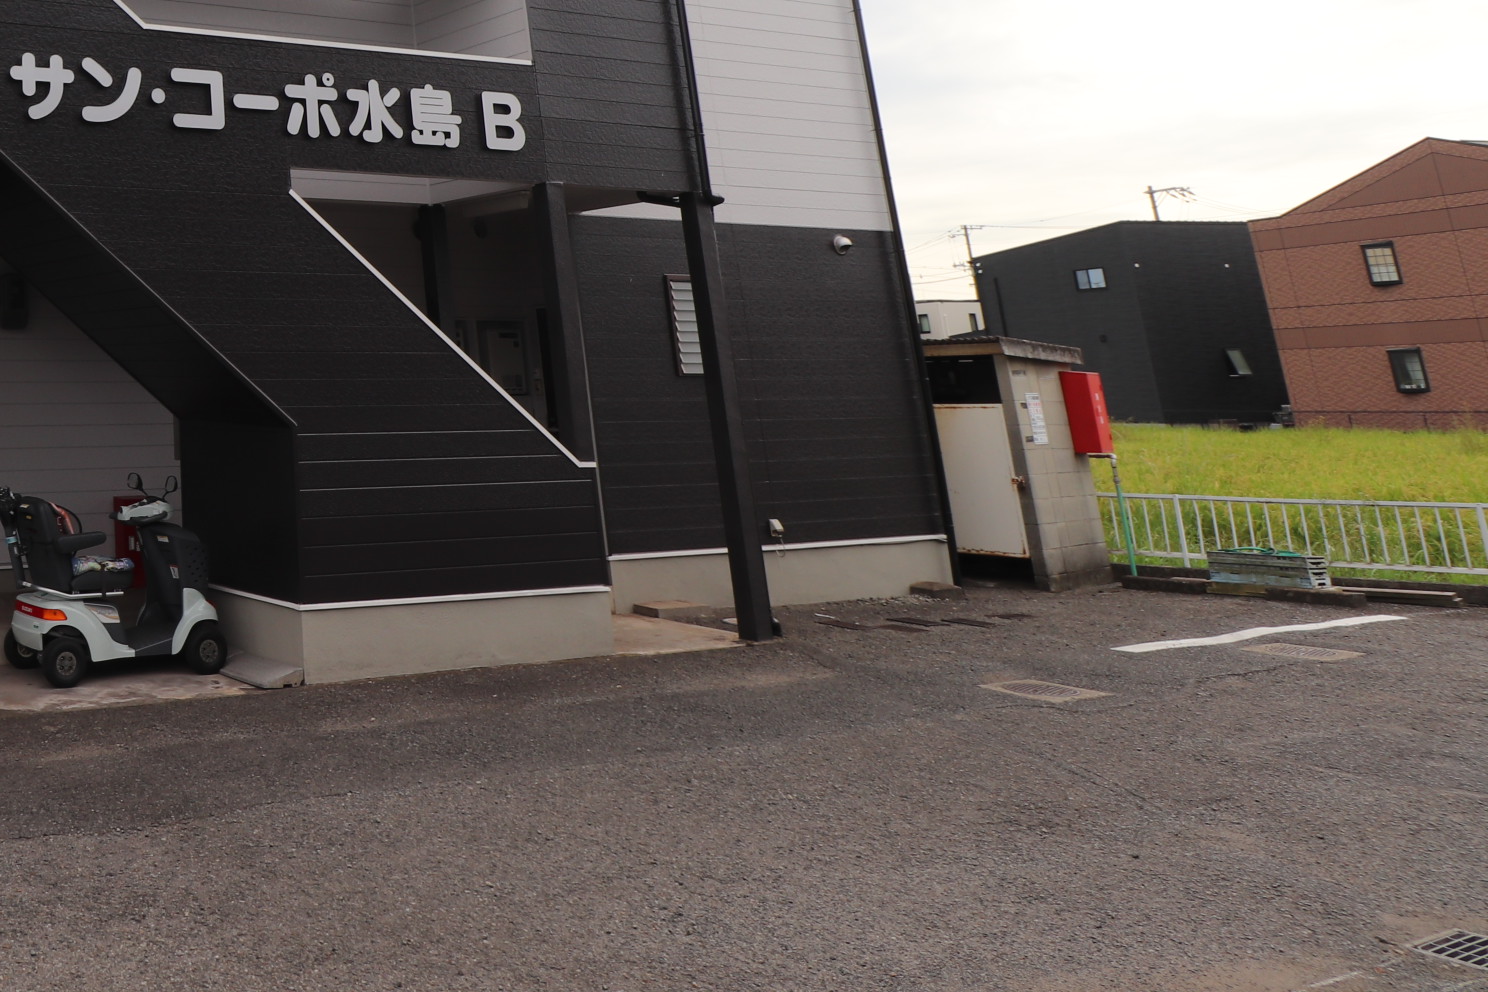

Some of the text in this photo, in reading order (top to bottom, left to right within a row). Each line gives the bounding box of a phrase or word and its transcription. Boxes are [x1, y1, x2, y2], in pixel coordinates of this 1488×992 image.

[10, 52, 526, 152] サン・コーポ水島 B
